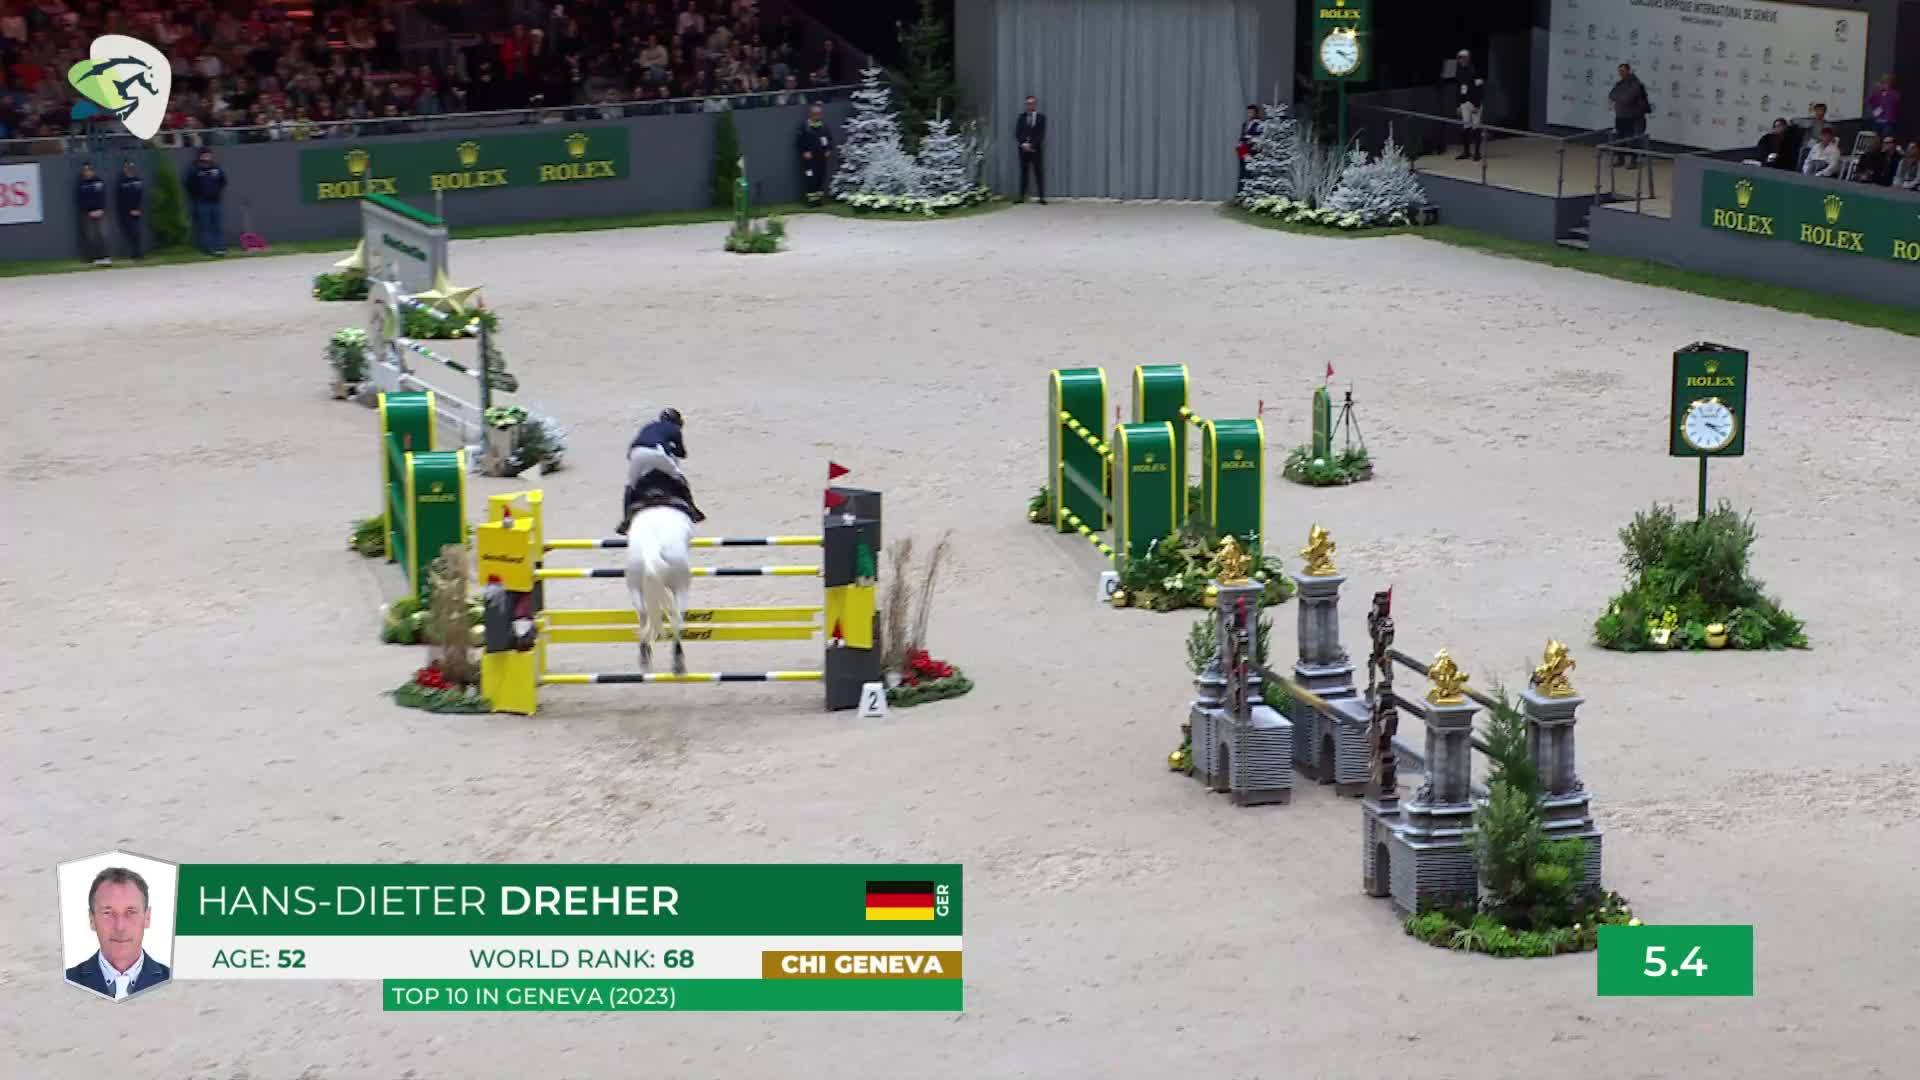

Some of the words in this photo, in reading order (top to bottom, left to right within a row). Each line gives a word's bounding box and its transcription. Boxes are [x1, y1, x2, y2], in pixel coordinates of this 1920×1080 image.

[1319, 8, 1360, 18] ROLEX
[431, 169, 507, 190] ROLEX
[540, 160, 616, 182] ROLEX
[318, 177, 397, 199] ROLEX
[1712, 208, 1775, 235] ROLEX
[1800, 223, 1864, 252] ROLEX
[1687, 376, 1736, 386] ROLEX
[869, 691, 878, 711] 2
